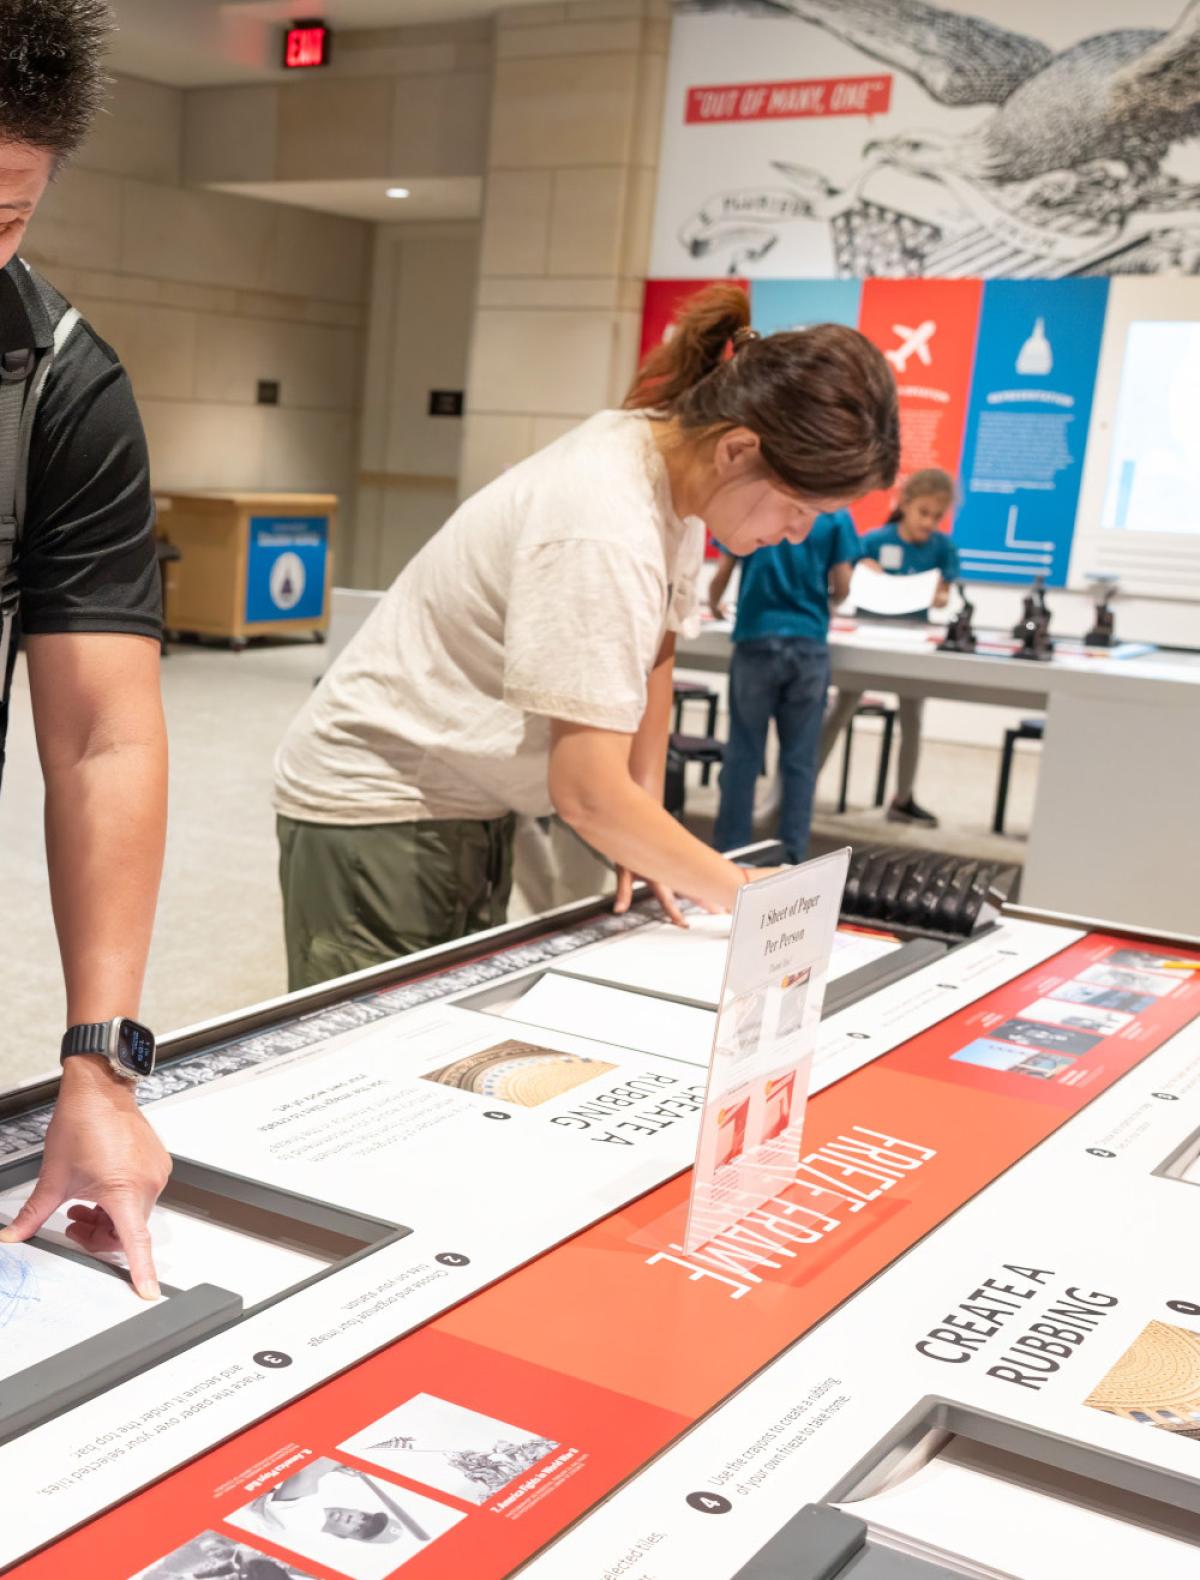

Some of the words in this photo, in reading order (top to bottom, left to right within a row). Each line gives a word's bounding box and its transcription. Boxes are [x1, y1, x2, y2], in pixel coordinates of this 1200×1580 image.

[286, 28, 325, 67] EXIT
[738, 87, 769, 116] OF
[766, 904, 789, 927] Sheet
[797, 894, 821, 914] Paper
[763, 938, 780, 956] Per
[779, 928, 805, 949] Person
[550, 1071, 680, 1130] RUBBING
[591, 1131, 636, 1147] A
[774, 1125, 937, 1213] FRIEZE
[644, 1195, 841, 1299] FRAME
[915, 1278, 1037, 1363] CREATE
[1002, 1263, 1056, 1285] A
[985, 1286, 1119, 1390] RUBBING
[220, 1365, 246, 1378] and
[232, 1372, 268, 1389] Place
[184, 1377, 223, 1396] secure
[211, 1388, 236, 1400] the
[140, 1403, 177, 1421] under
[176, 1398, 214, 1417] paper
[93, 1432, 120, 1445] top
[116, 1421, 143, 1434] the
[152, 1417, 181, 1432] over
[708, 1468, 734, 1486] Use
[725, 1456, 748, 1473] the
[741, 1430, 777, 1460] crayons
[768, 1424, 785, 1434] to
[779, 1400, 808, 1427] create
[808, 1377, 842, 1402] rubbing
[120, 1431, 155, 1448] your
[736, 1483, 749, 1496] of
[746, 1468, 769, 1489] your
[764, 1453, 786, 1471] own
[776, 1431, 808, 1455] frieze
[799, 1426, 815, 1437] to
[807, 1411, 832, 1430] take
[71, 1449, 128, 1477] selected
